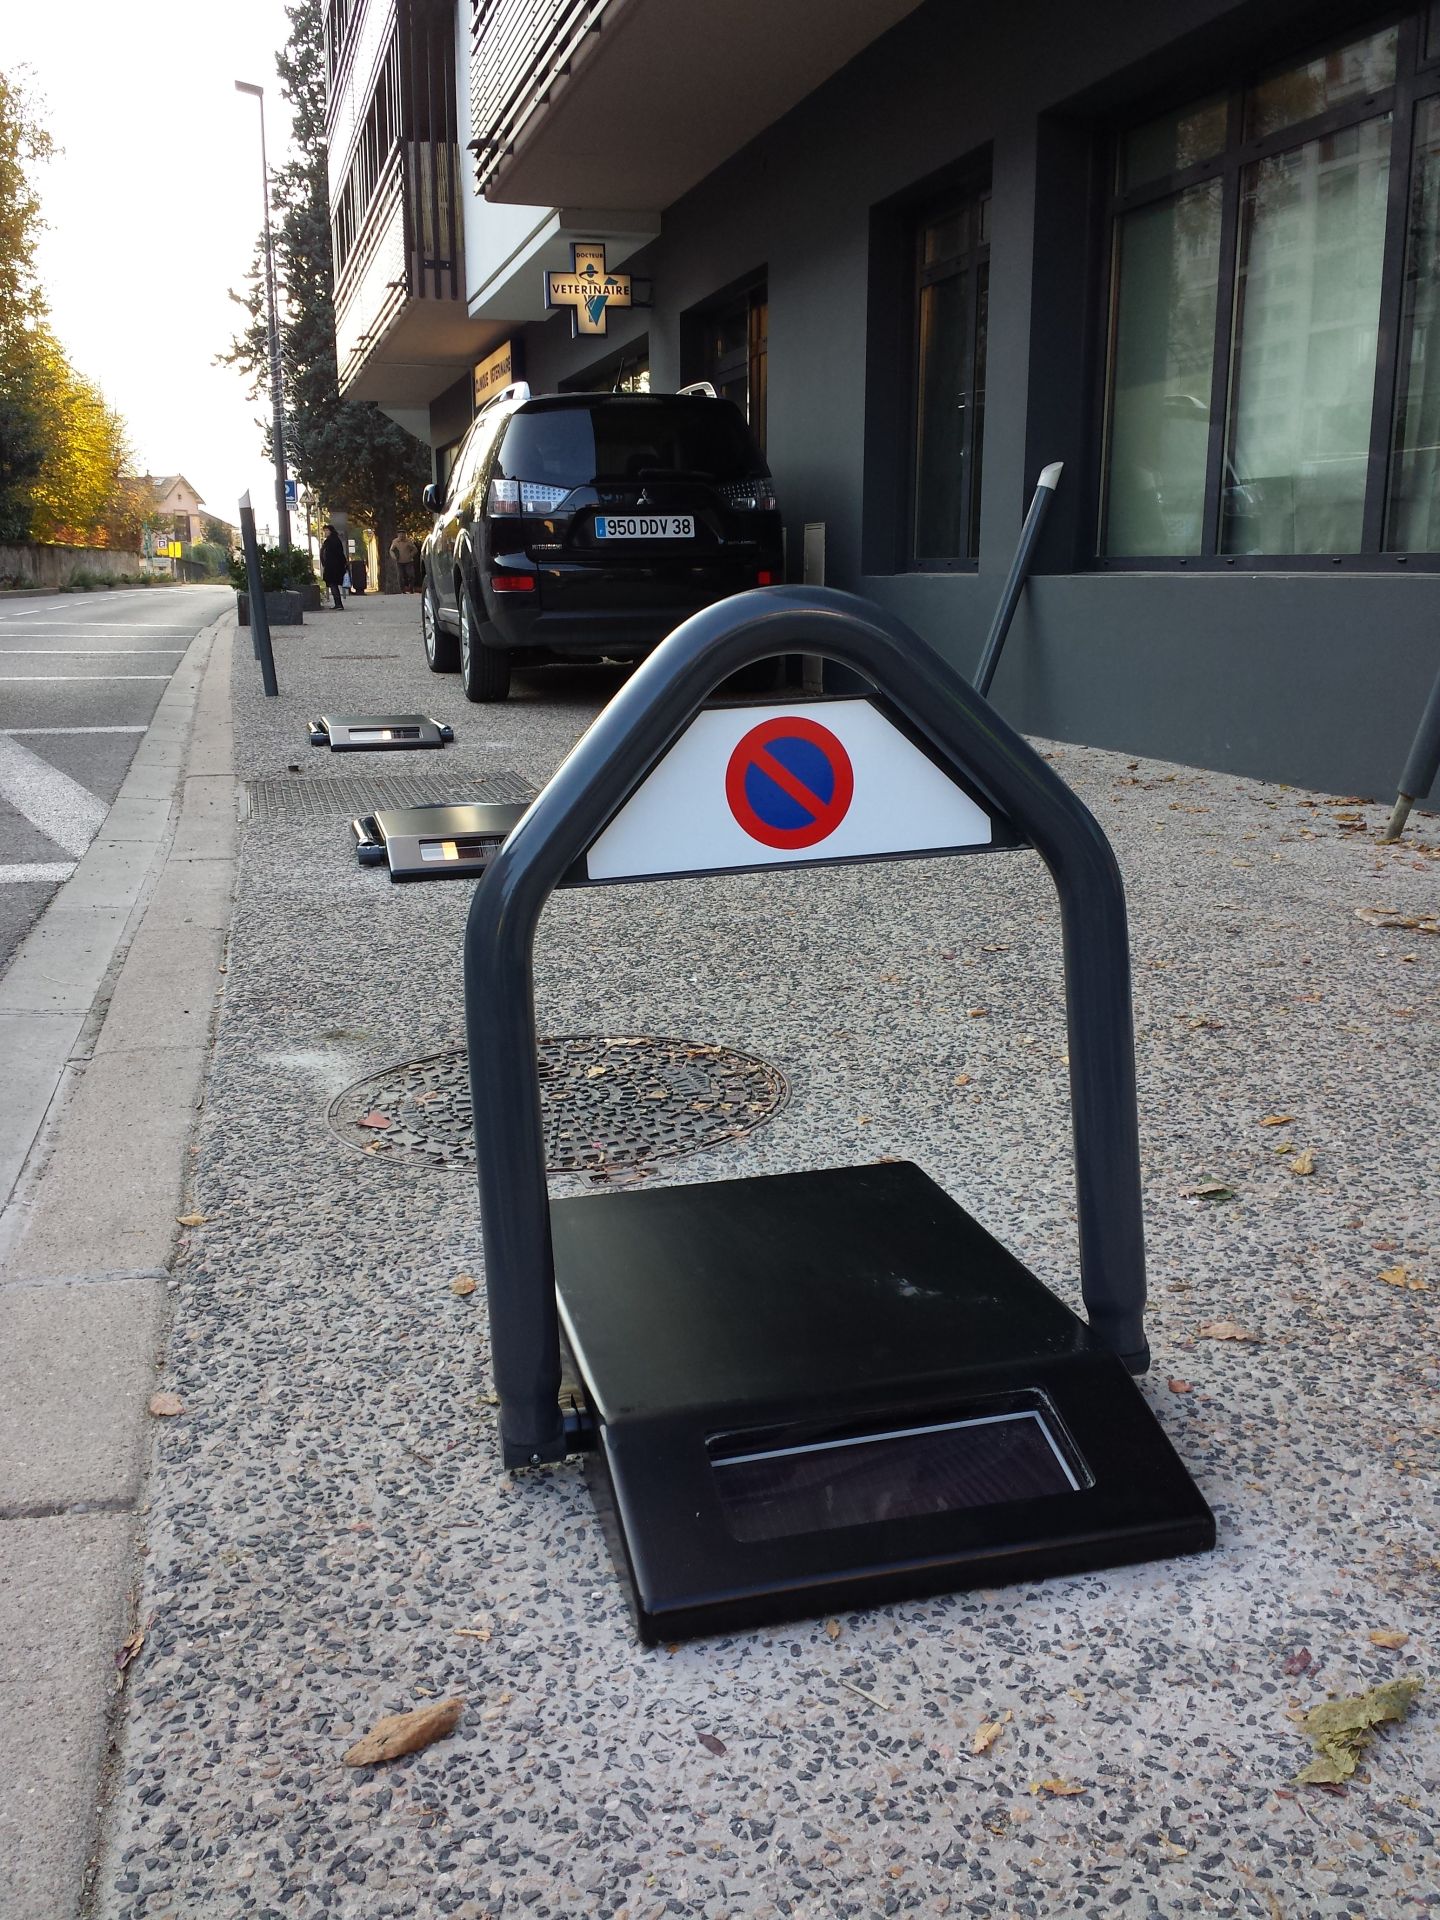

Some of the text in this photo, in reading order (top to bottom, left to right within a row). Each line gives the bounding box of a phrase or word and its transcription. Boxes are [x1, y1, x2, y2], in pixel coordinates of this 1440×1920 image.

[552, 284, 630, 295] VETERINAIRE
[607, 519, 636, 535] 950
[640, 519, 668, 535] DDV
[672, 518, 691, 535] 38
